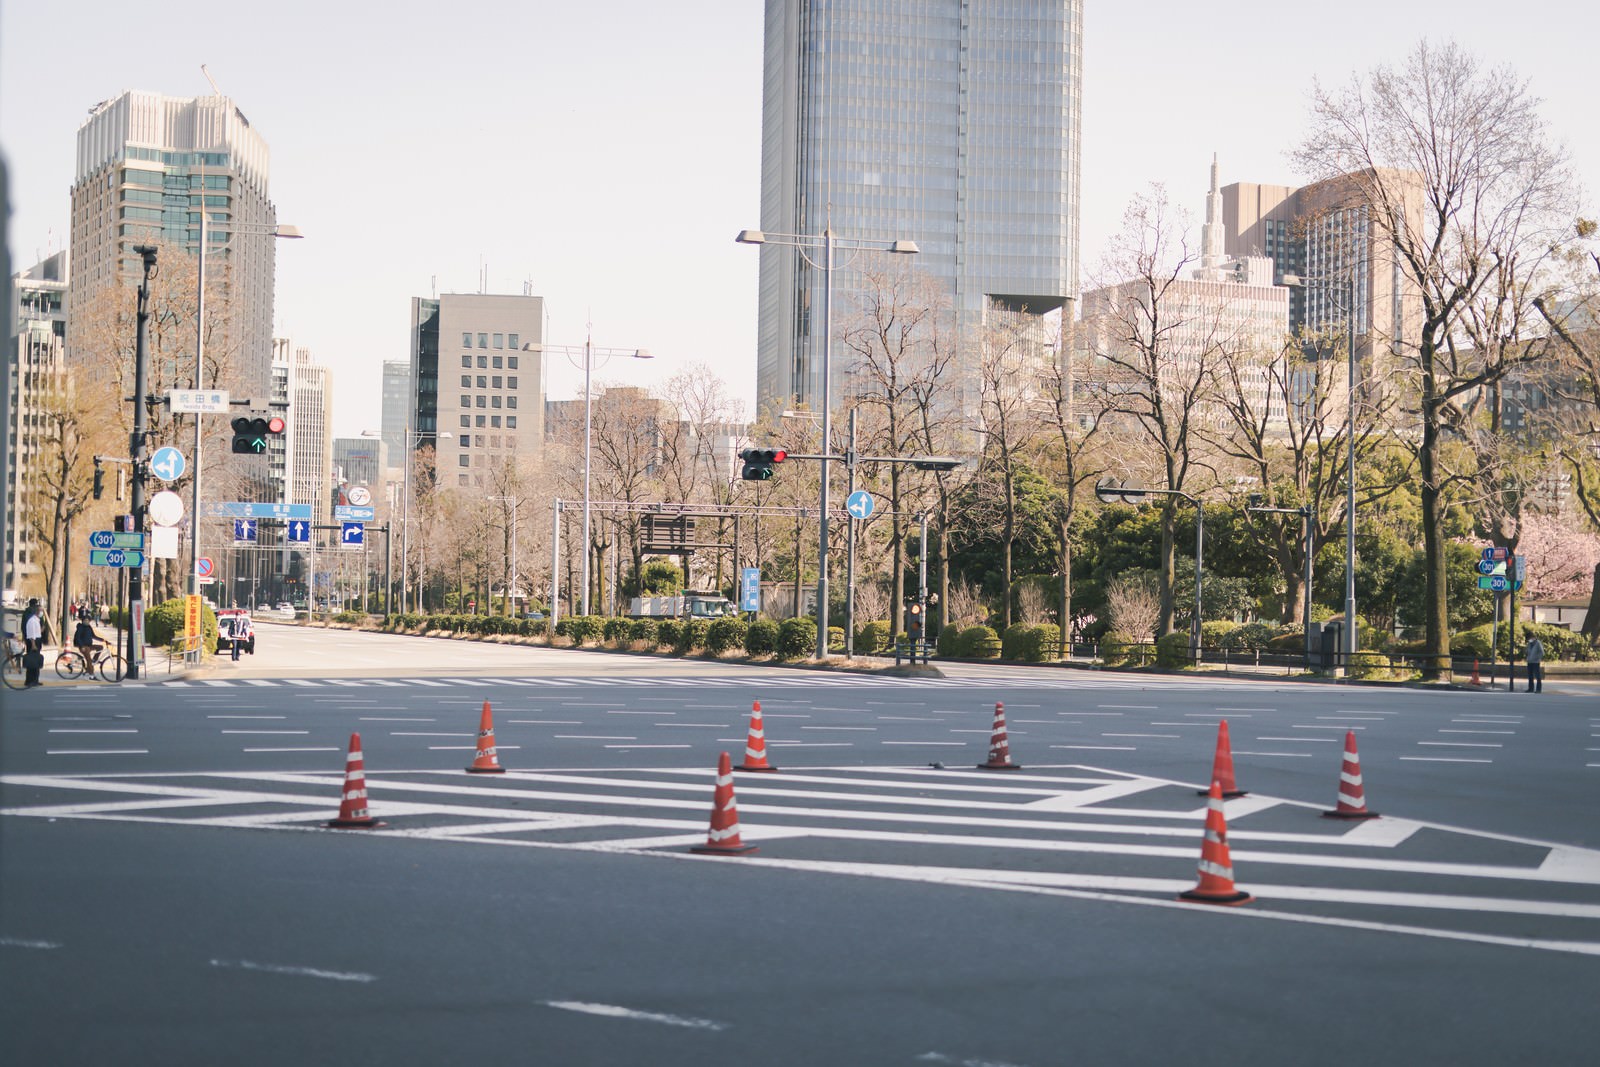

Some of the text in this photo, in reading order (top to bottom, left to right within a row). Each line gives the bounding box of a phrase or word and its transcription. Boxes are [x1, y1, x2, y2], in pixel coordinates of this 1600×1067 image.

[97, 535, 113, 545] 301
[108, 553, 124, 564] 301
[1492, 580, 1505, 588] 301
